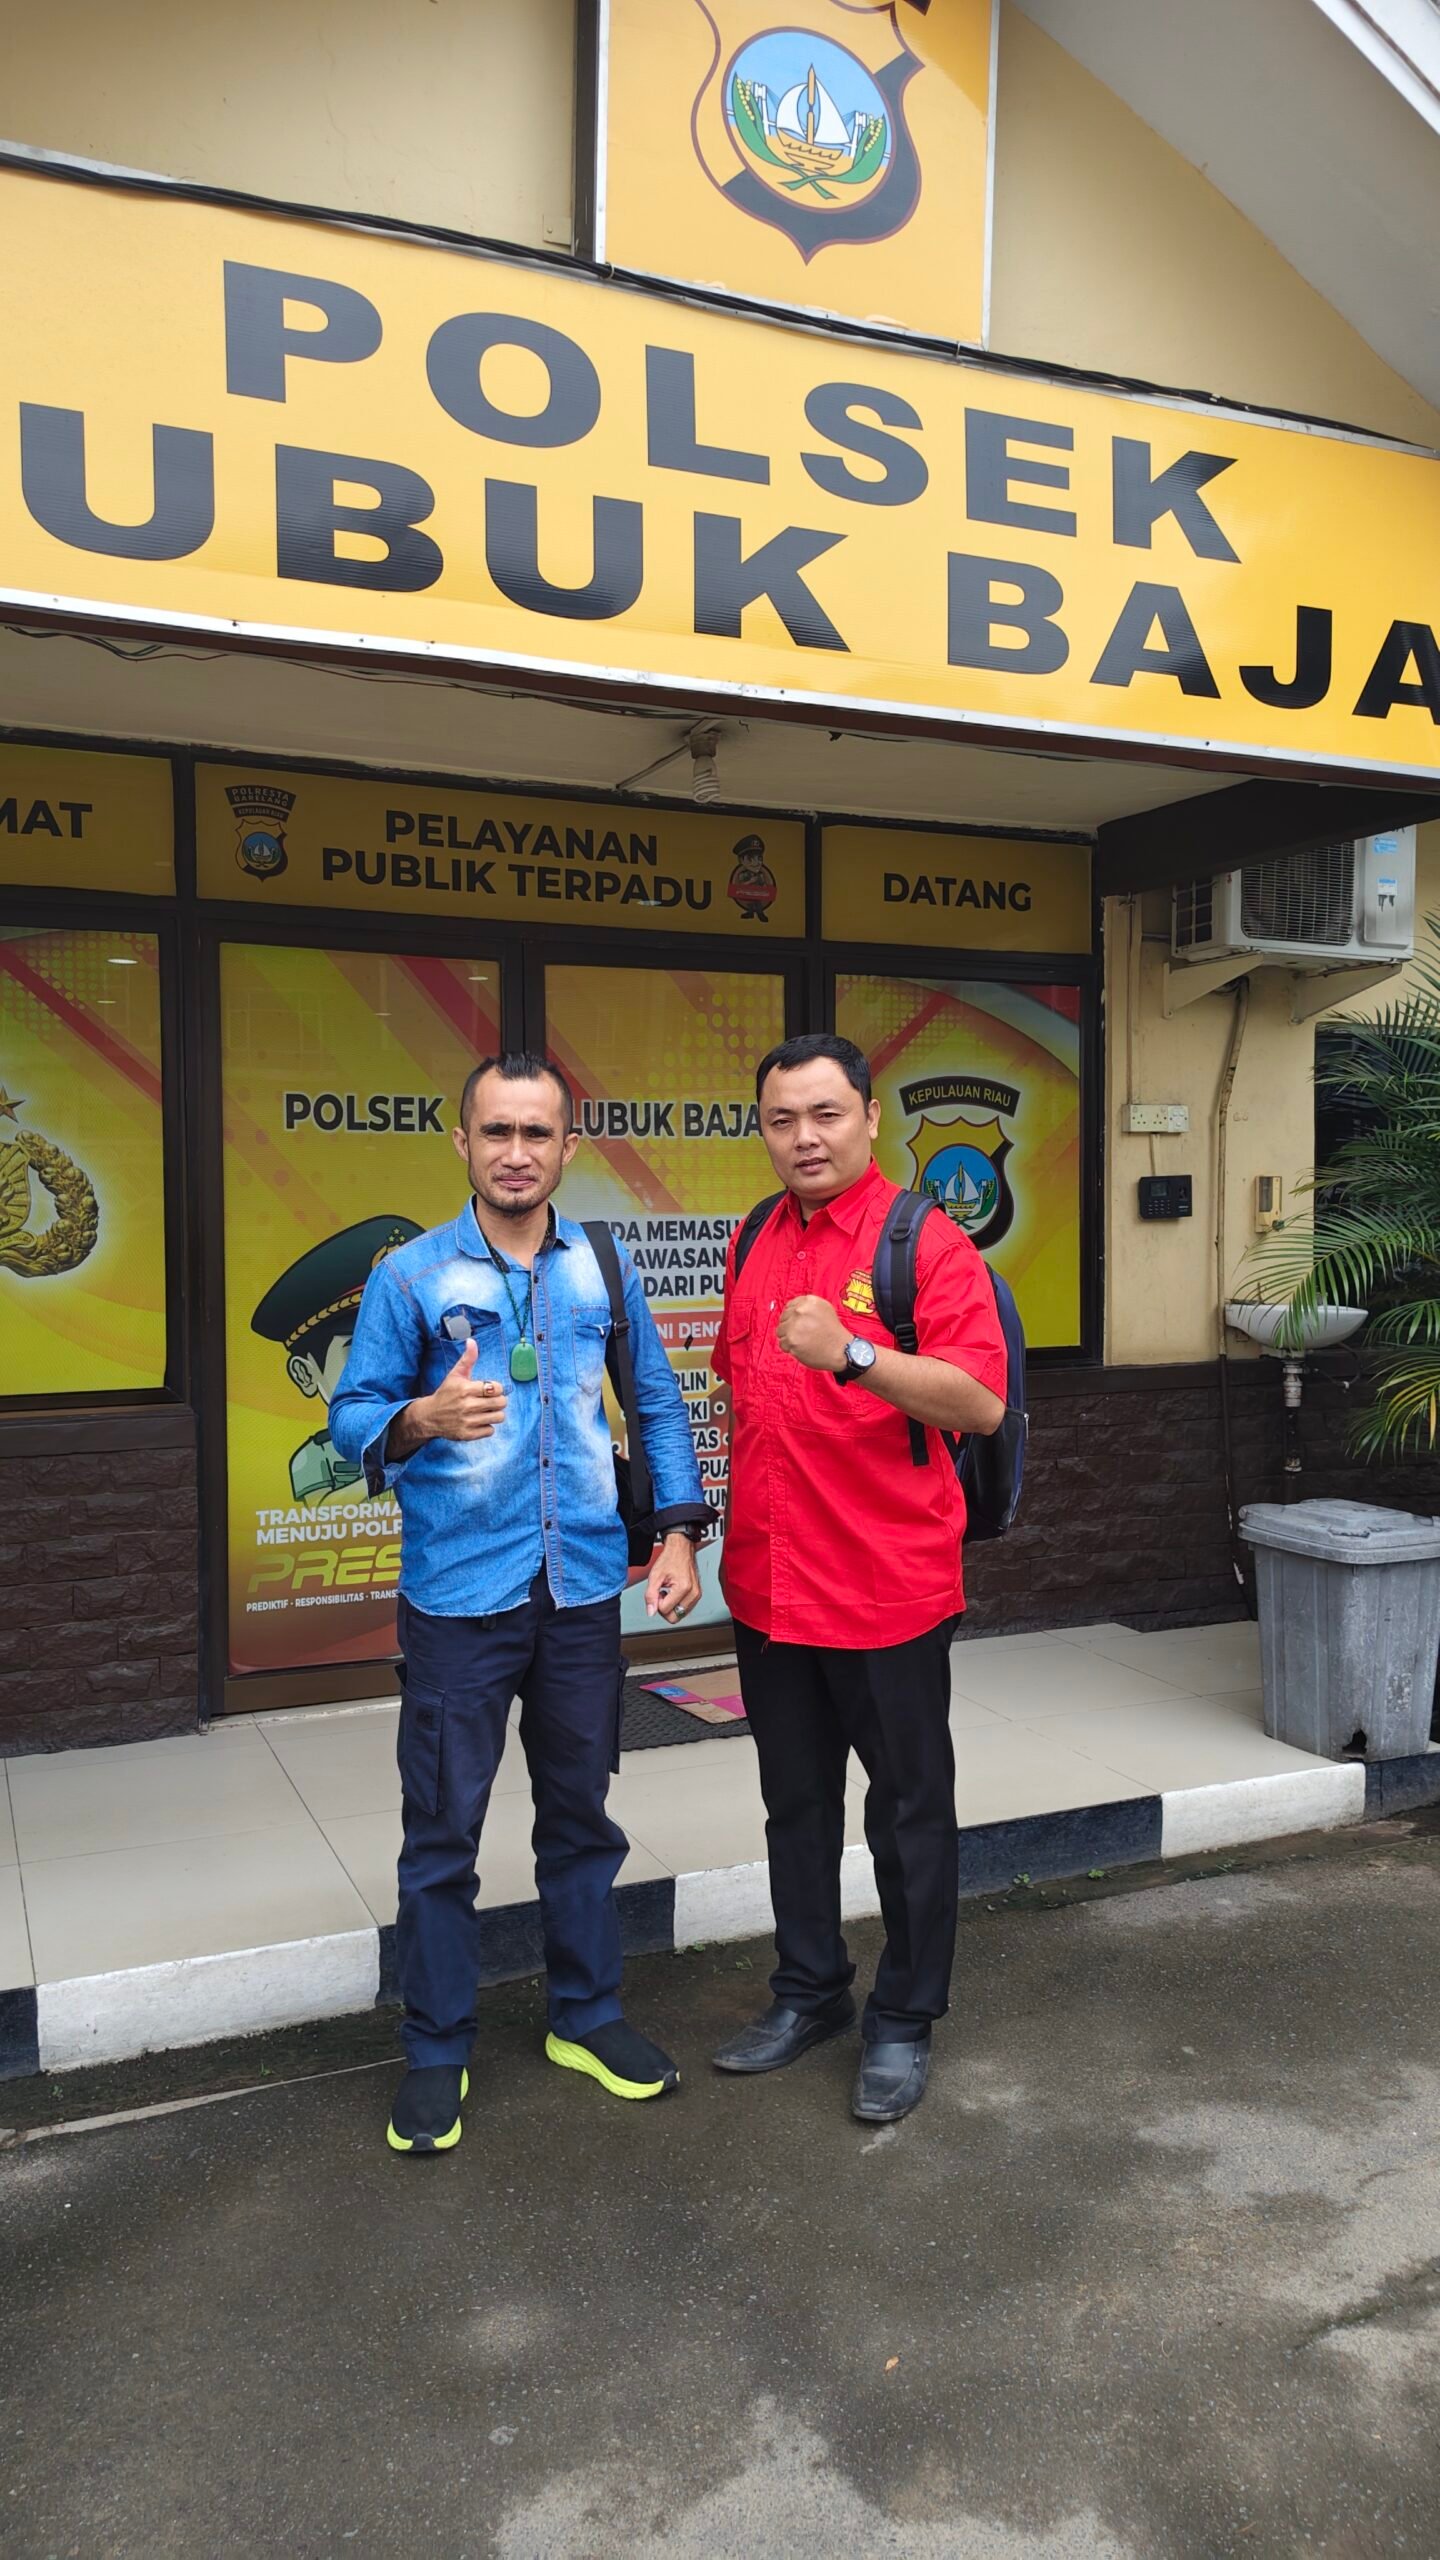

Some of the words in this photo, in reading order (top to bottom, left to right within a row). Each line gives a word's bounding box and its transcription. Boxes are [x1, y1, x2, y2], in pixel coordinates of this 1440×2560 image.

[223, 260, 1242, 564] POLSEK
[947, 551, 1440, 726] BAJA
[385, 809, 658, 866] PELAYANAN
[322, 847, 496, 895] PUBLIK
[508, 863, 712, 910] TERPADU
[883, 872, 1032, 912] DATANG
[285, 1093, 445, 1132] POLSEK
[908, 1085, 980, 1106] KEPULAUAN
[983, 1088, 1011, 1107] RIAU
[643, 1274, 695, 1297] DARI
[256, 1523, 347, 1545] MENUJU
[246, 1599, 289, 1612] PREDIKTIF
[295, 1592, 364, 1607] RESPONSIBILITAS
